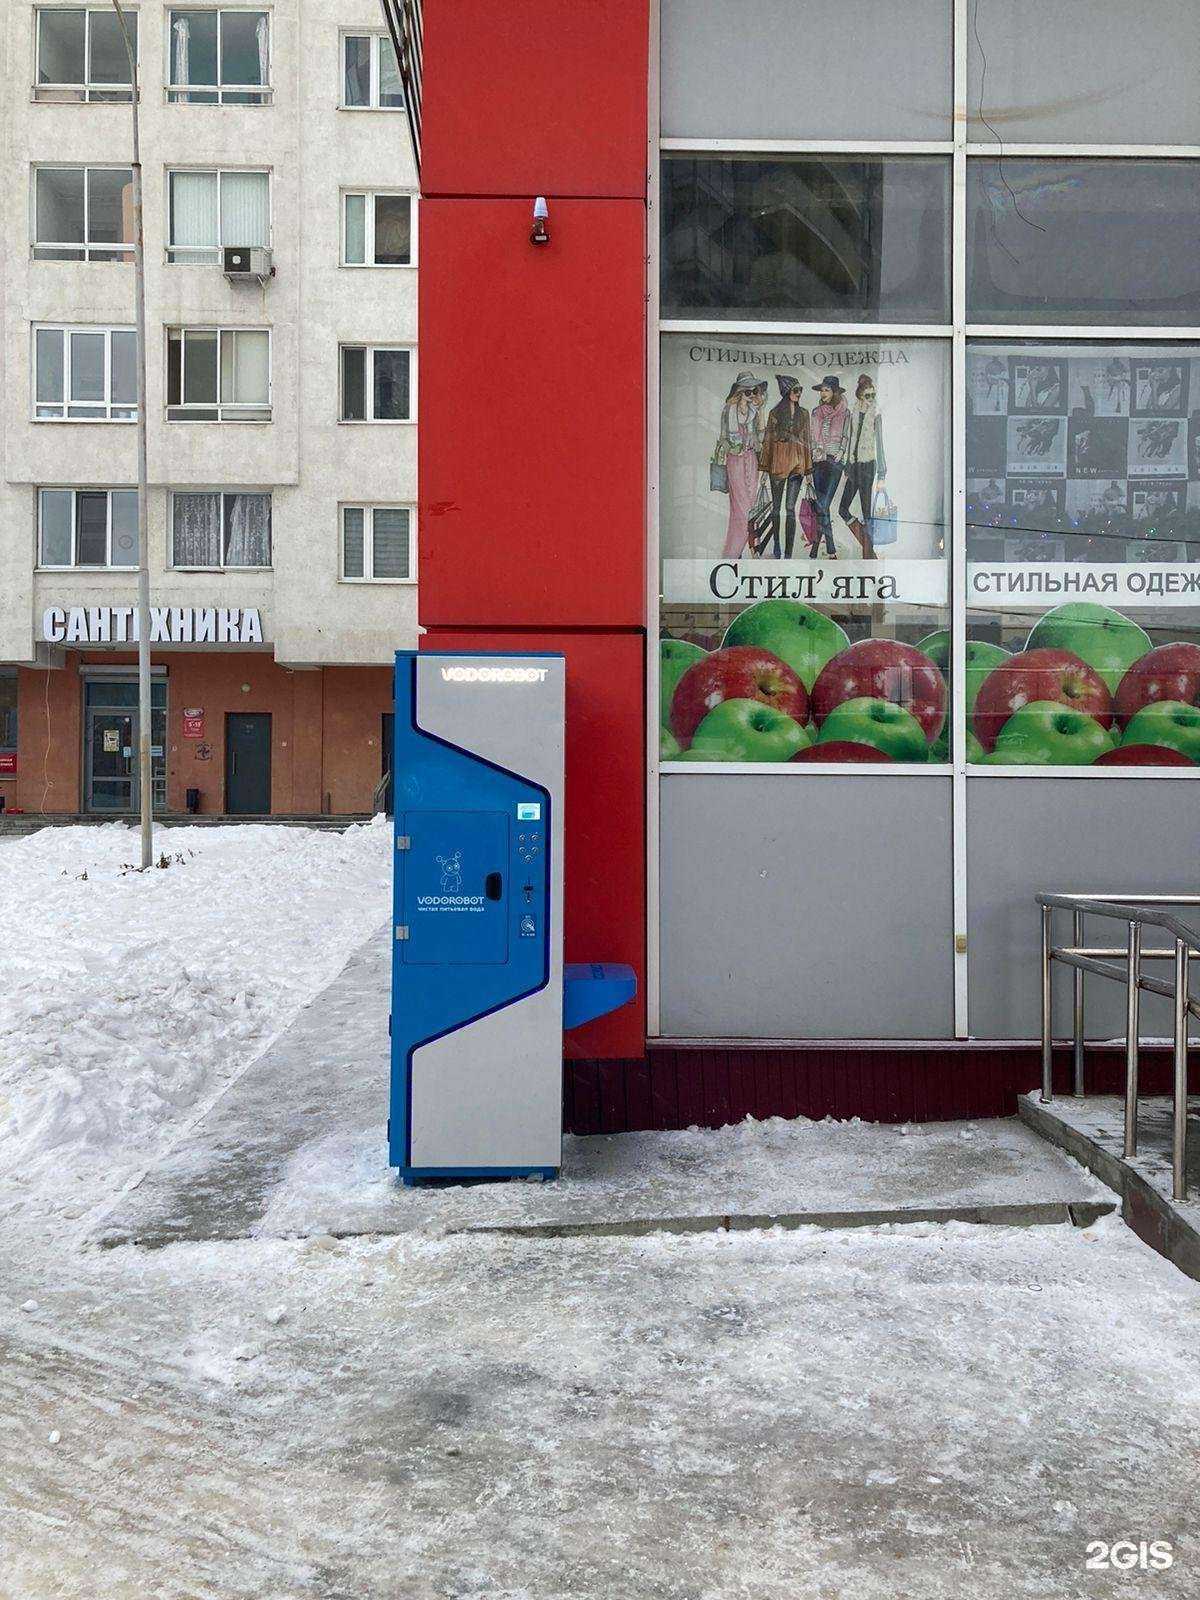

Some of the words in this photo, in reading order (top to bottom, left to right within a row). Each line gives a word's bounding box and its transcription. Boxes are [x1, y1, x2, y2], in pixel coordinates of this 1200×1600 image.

[689, 346, 805, 367] СТИЛЬНАЯ
[812, 350, 910, 368] ОДЕЖДА
[973, 572, 1118, 593] СТИЛЬНАЯ
[43, 606, 263, 642] САНТХНИКА
[441, 667, 549, 682] VODOROBOT
[417, 896, 485, 905] VODOROBOT
